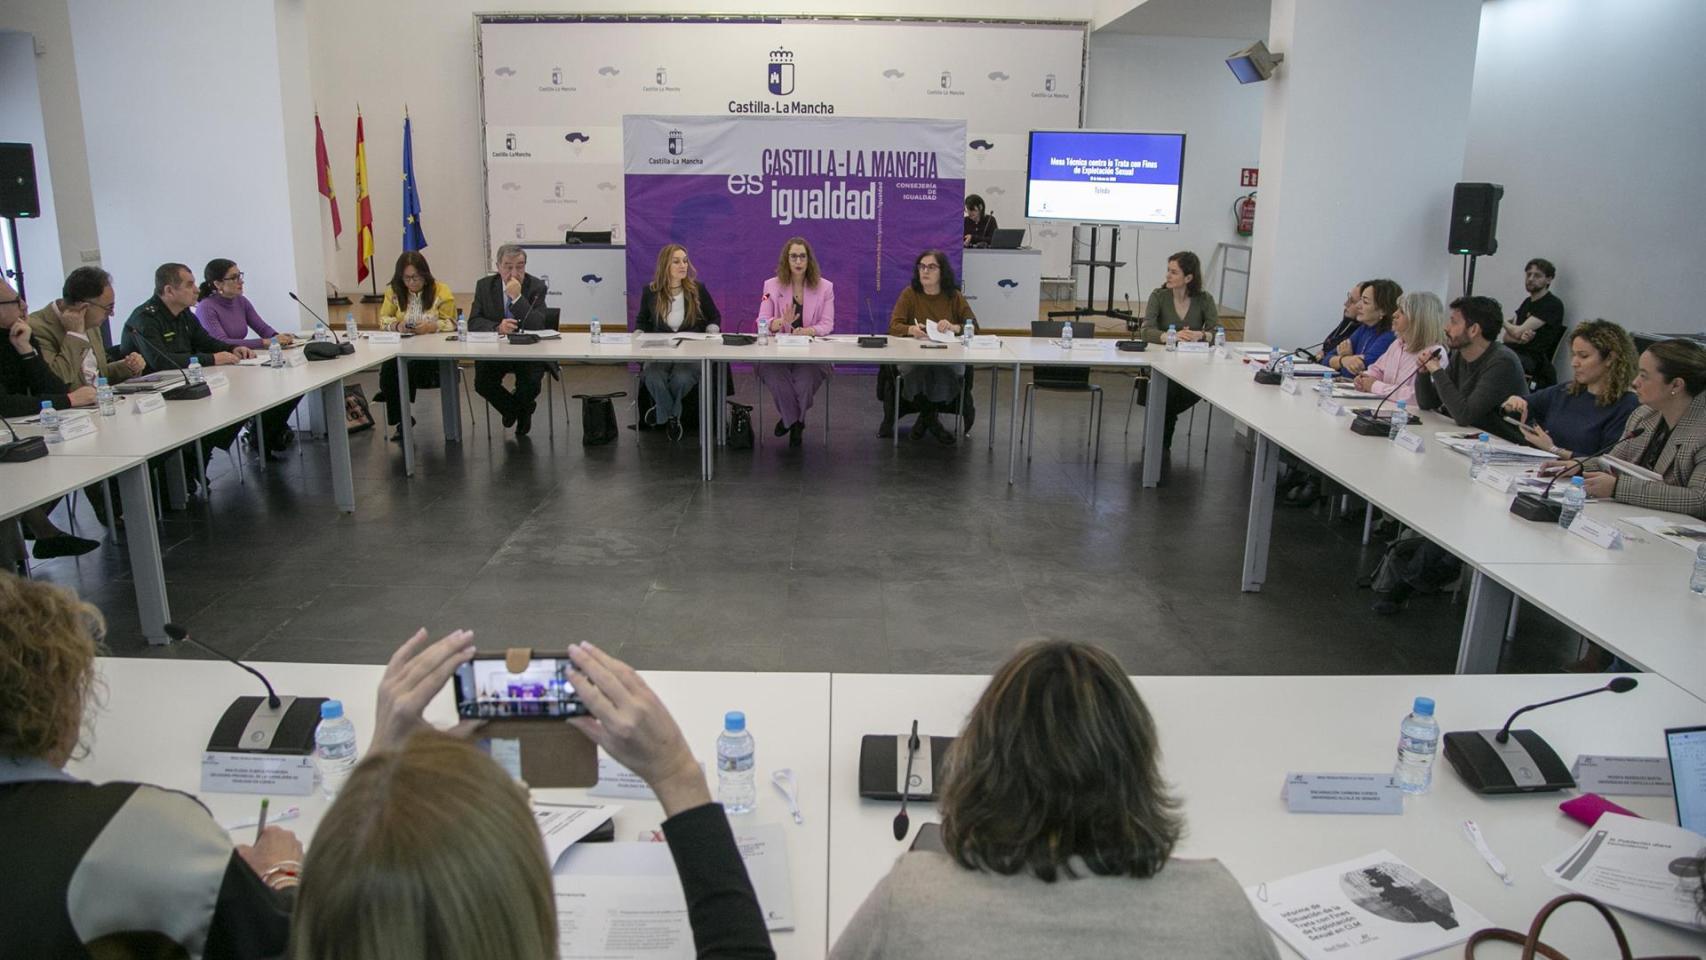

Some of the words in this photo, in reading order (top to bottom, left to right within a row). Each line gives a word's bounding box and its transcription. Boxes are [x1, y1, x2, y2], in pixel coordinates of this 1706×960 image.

[791, 101, 835, 115] Mancha
[681, 157, 704, 166] Mancha
[871, 150, 939, 179] MANCHA
[1050, 157, 1065, 166] Mesa
[1066, 157, 1087, 167] Técnica
[1088, 159, 1107, 167] contra
[1115, 159, 1130, 168] Trata
[1142, 160, 1158, 169] Fines
[1082, 167, 1114, 176] Explotación
[1115, 168, 1134, 176] Sexual
[727, 174, 764, 196] es
[895, 182, 938, 190] CONSEJERÍA
[771, 181, 876, 225] igualdad
